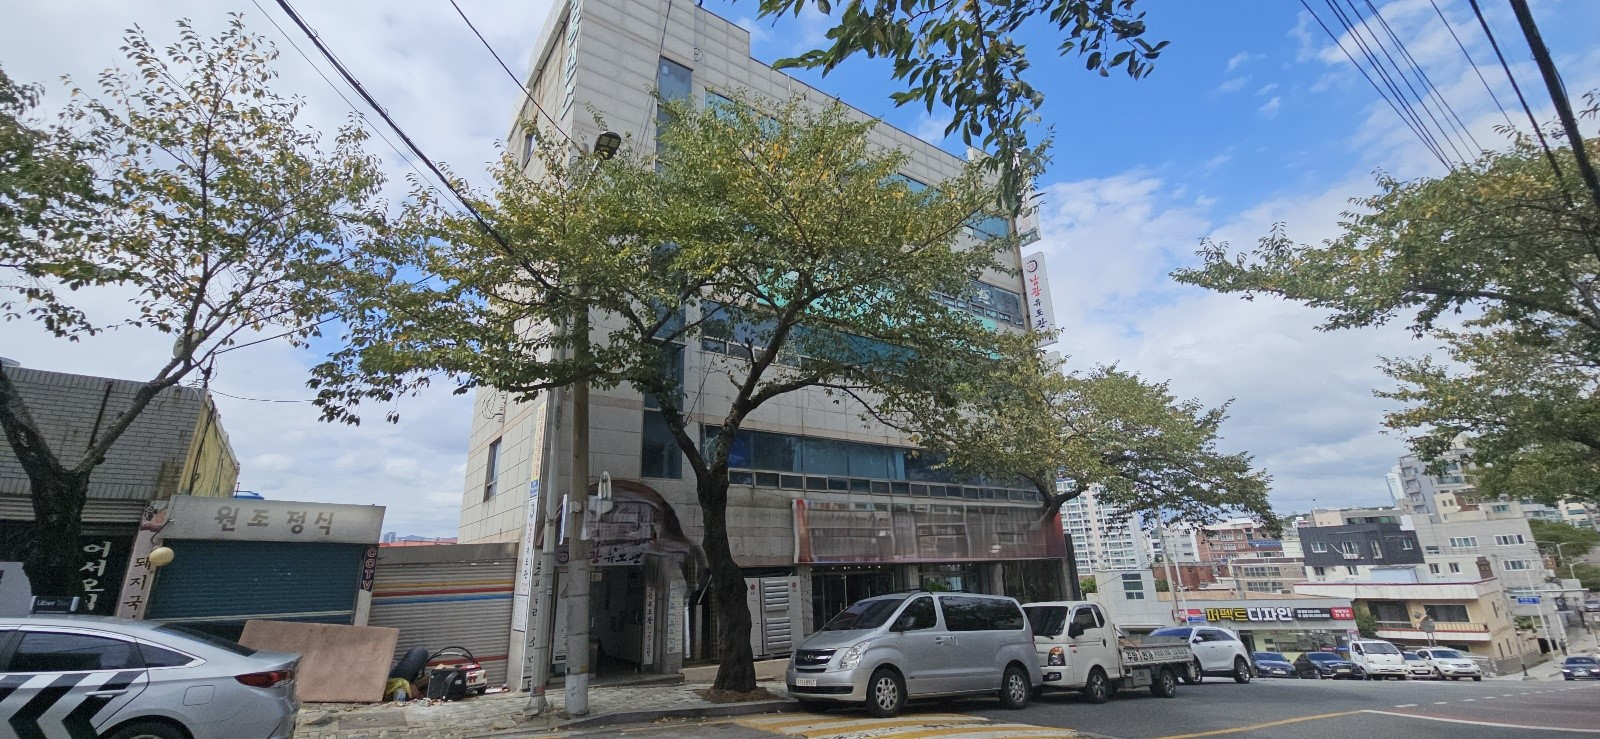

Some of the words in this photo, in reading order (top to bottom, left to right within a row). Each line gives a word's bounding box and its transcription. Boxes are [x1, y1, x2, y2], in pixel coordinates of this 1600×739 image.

[214, 506, 334, 535] 원조정식
[123, 556, 151, 618] 돼지국
[362, 547, 378, 590] CCTV
